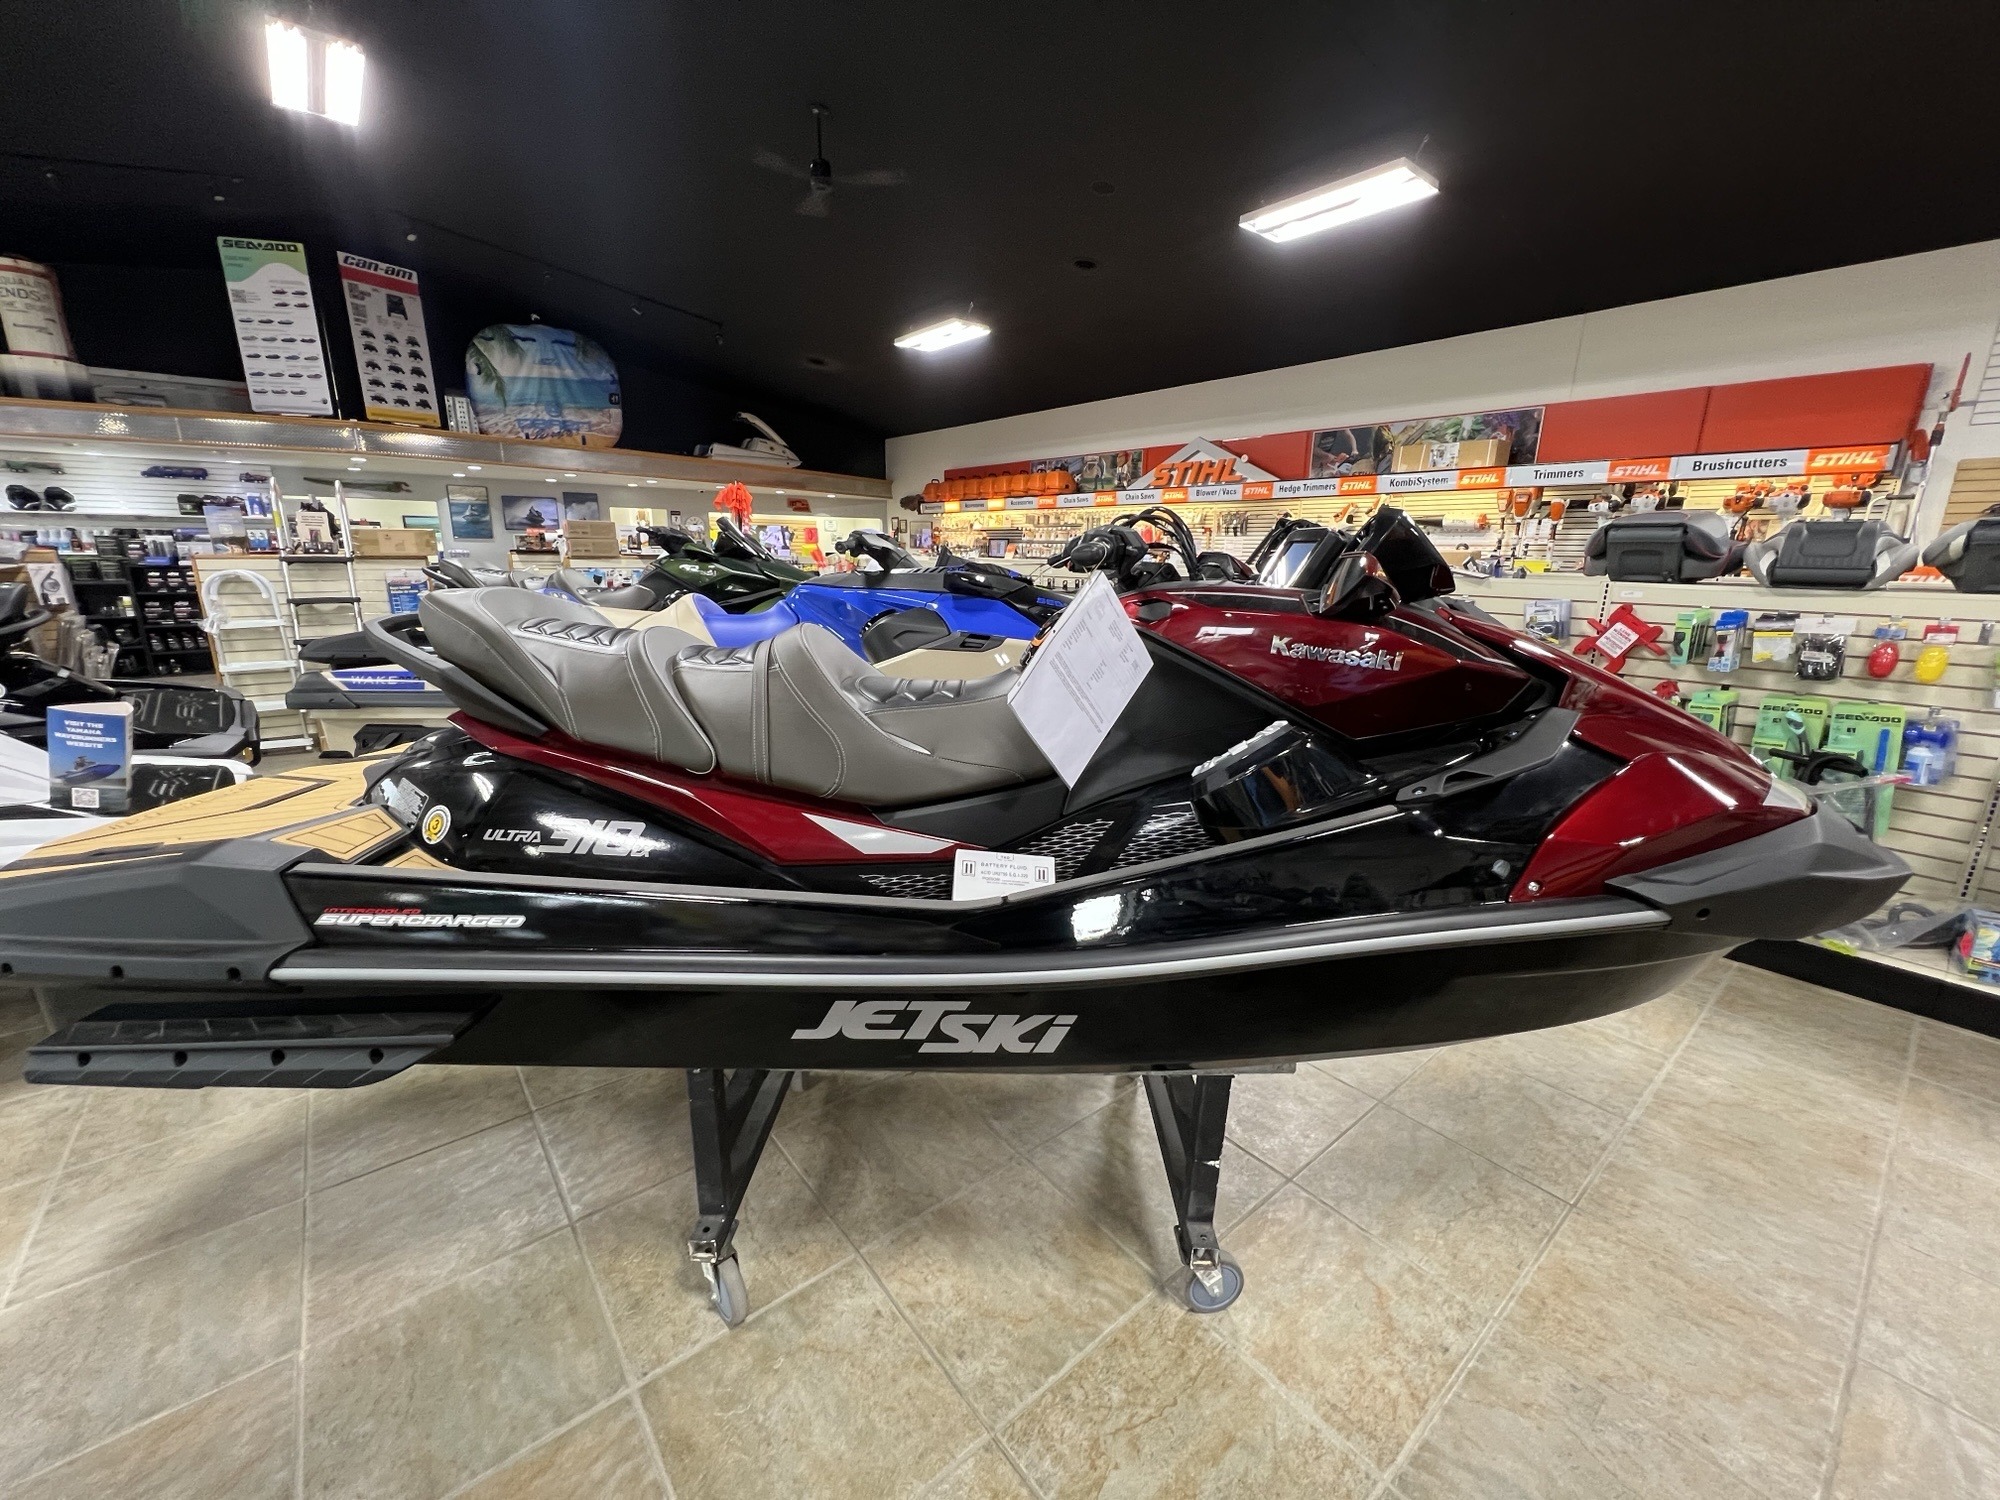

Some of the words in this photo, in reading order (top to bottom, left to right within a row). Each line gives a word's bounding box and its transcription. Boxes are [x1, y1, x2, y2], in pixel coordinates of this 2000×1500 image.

[343, 255, 413, 281] can-am
[1692, 456, 1788, 472] Brushcutters
[1811, 450, 1879, 468] STIHL
[1153, 457, 1242, 487] STIHL
[1533, 467, 1584, 480] Trimmers
[1613, 464, 1664, 478] STIHL
[1389, 475, 1449, 488] KombiSystem
[1459, 473, 1499, 485] STIHL
[1244, 484, 1270, 495] STIHL
[1279, 484, 1300, 493] Hedge
[1302, 482, 1336, 491] Trimmers
[1341, 480, 1373, 491] STIHL
[1096, 494, 1115, 503] STIHL
[1125, 493, 1139, 501] Chain
[1140, 492, 1155, 500] Saws
[1163, 491, 1186, 500] STIHL
[1270, 634, 1404, 671] Kawasaki
[351, 675, 398, 685] WAKE
[64, 719, 84, 727] VISIT
[66, 727, 102, 735] YAMAHA
[54, 731, 117, 743] WAVERUNNERS
[66, 740, 103, 748] WEBSITE
[483, 828, 542, 843] ULTRA
[980, 861, 1008, 869] BATTERY
[324, 907, 422, 915] INTERCOOLED
[314, 914, 526, 928] SUPERCHARGED
